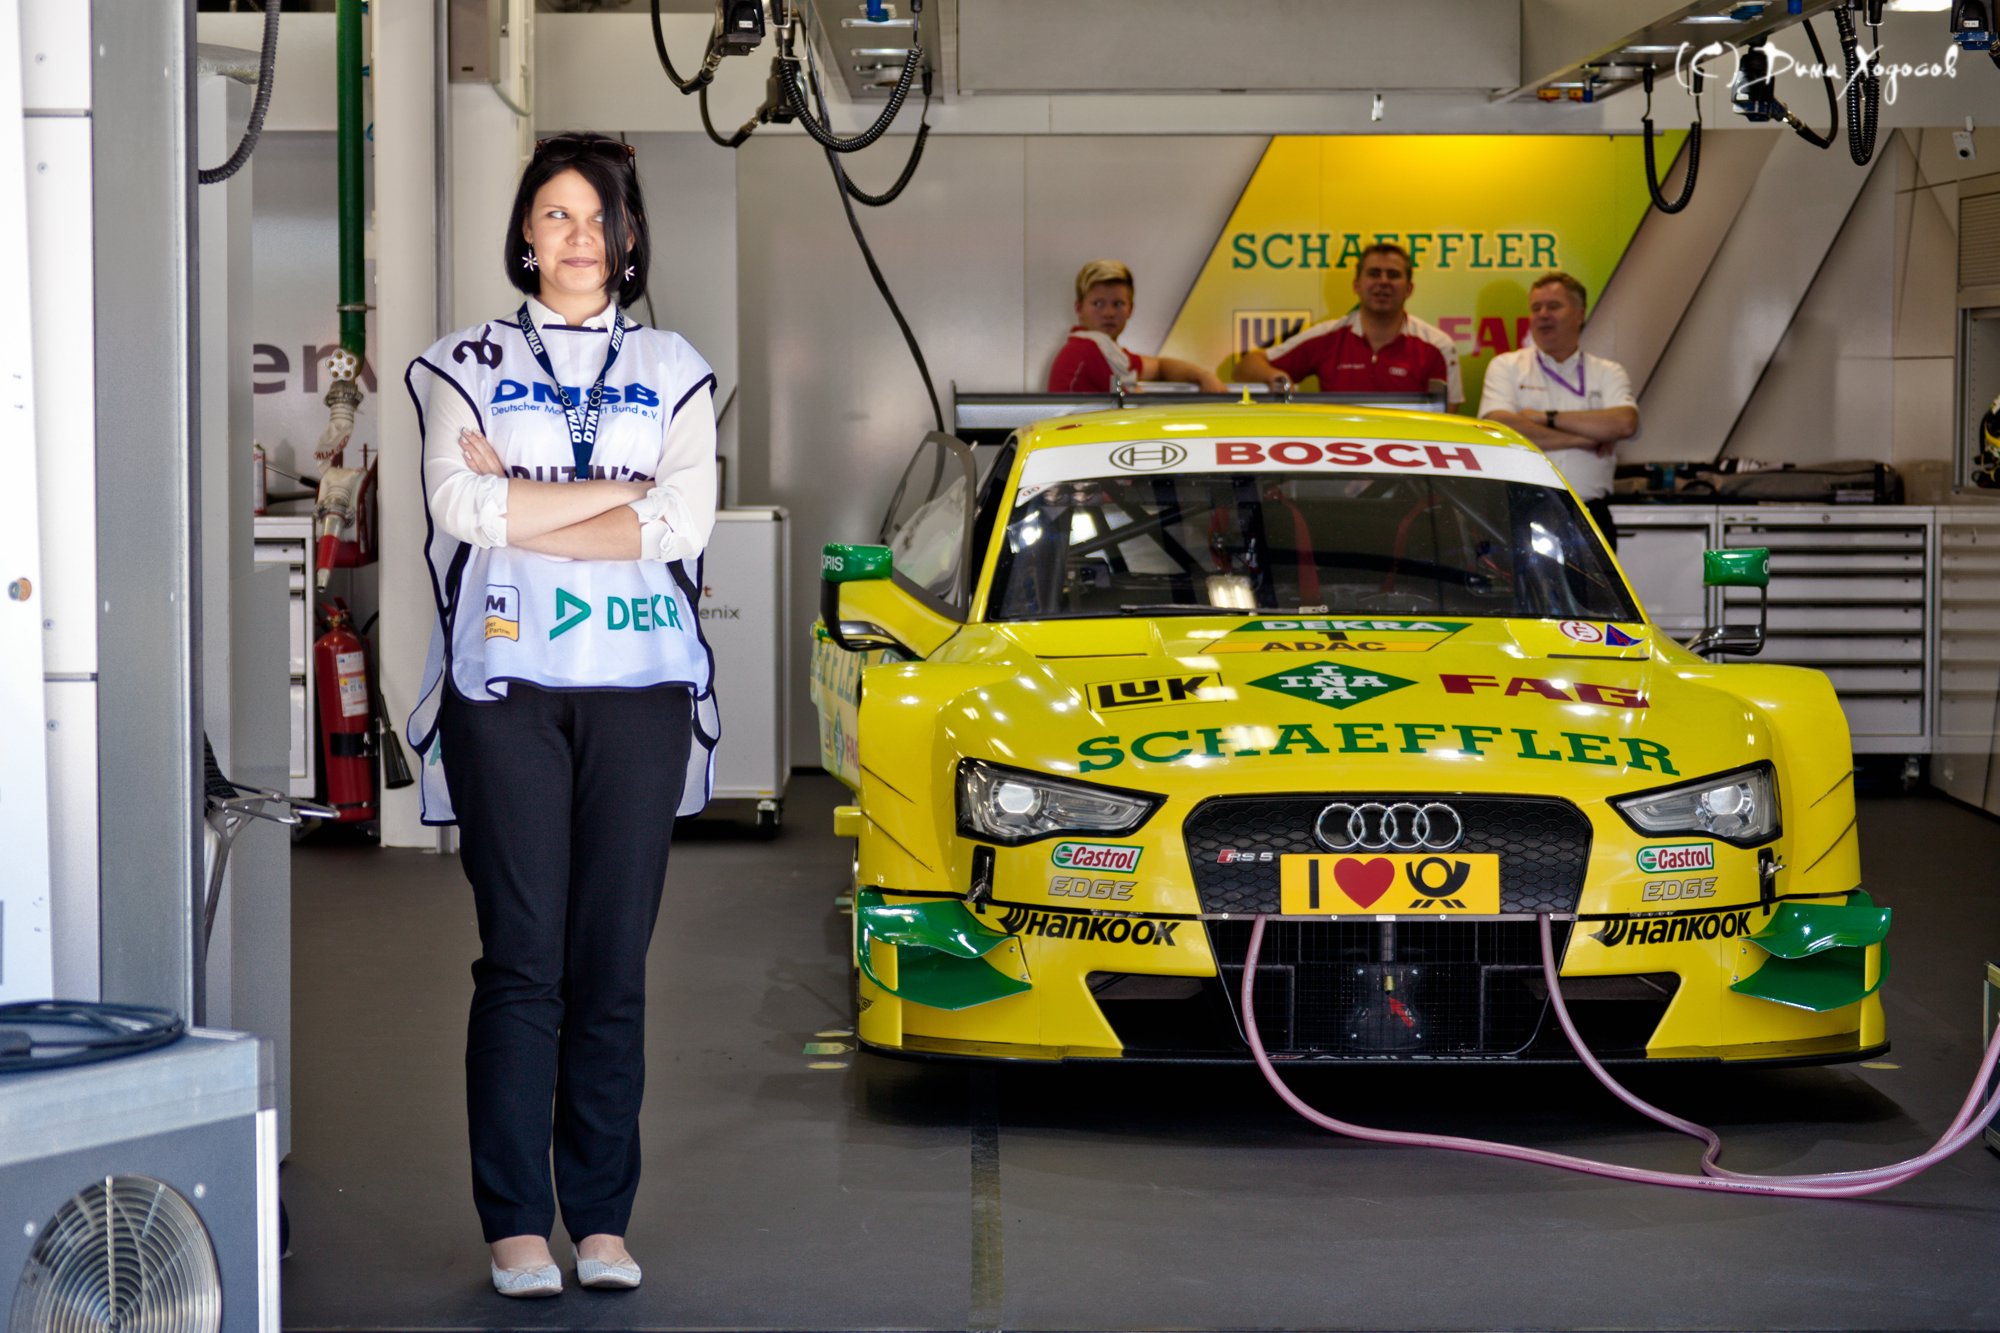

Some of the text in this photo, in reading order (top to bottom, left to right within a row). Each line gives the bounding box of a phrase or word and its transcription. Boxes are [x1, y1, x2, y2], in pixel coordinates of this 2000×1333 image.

[1232, 233, 1558, 269] SCHAFFLER
[1438, 317, 1530, 356] FA
[491, 378, 660, 407] DMSB
[491, 402, 541, 417] Deutscher
[611, 403, 639, 415] Bund
[1215, 441, 1483, 472] BOSCH
[607, 593, 684, 632] DEKR
[1261, 620, 1449, 632] DEKRA
[1261, 642, 1387, 652] ADAC
[1439, 673, 1650, 709] FAG
[1077, 723, 1680, 777] SCHAEFFLER
[1071, 845, 1135, 870] Castrol
[1658, 847, 1711, 870] Castrol
[1048, 875, 1138, 901] EDGE
[1642, 877, 1719, 902] EDGE
